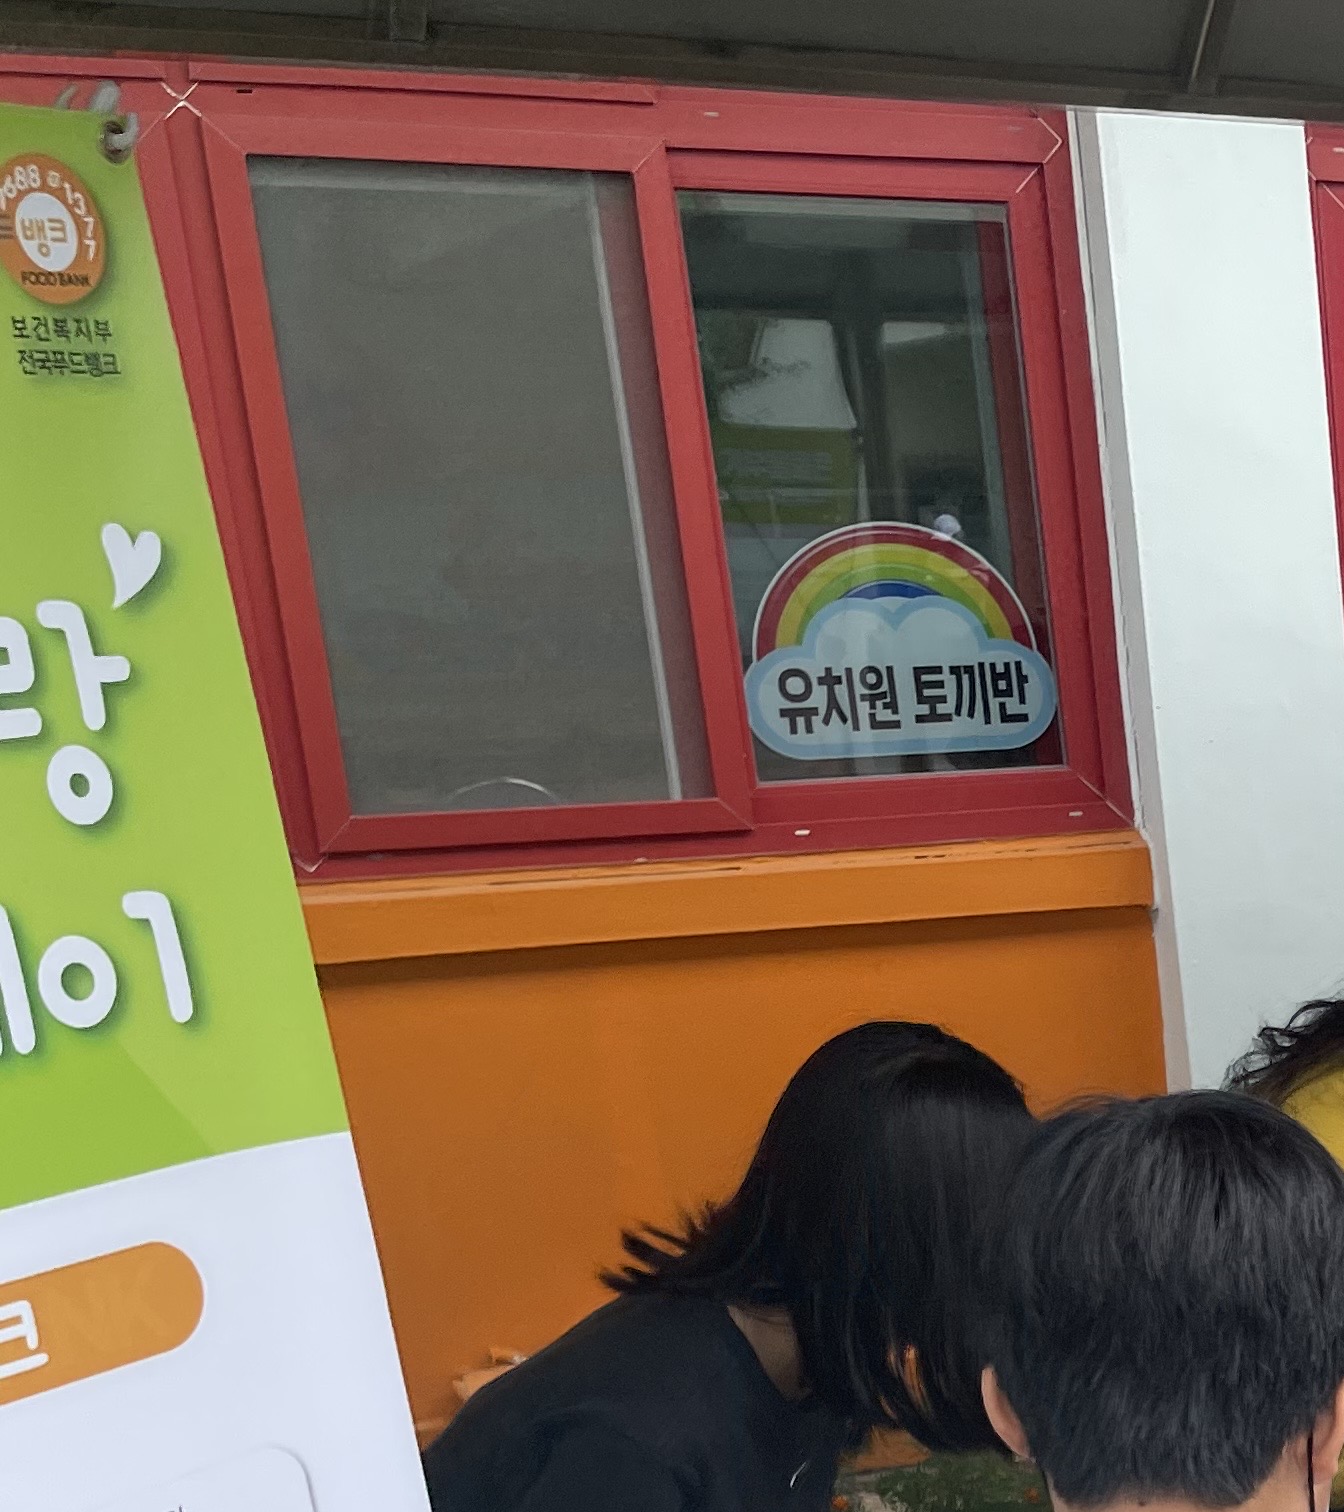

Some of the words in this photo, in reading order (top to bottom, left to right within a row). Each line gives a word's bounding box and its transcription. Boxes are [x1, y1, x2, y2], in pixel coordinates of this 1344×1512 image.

[11, 315, 112, 343] 보건복지부
[777, 664, 902, 737] 유치원
[911, 660, 1030, 727] 토끼반
